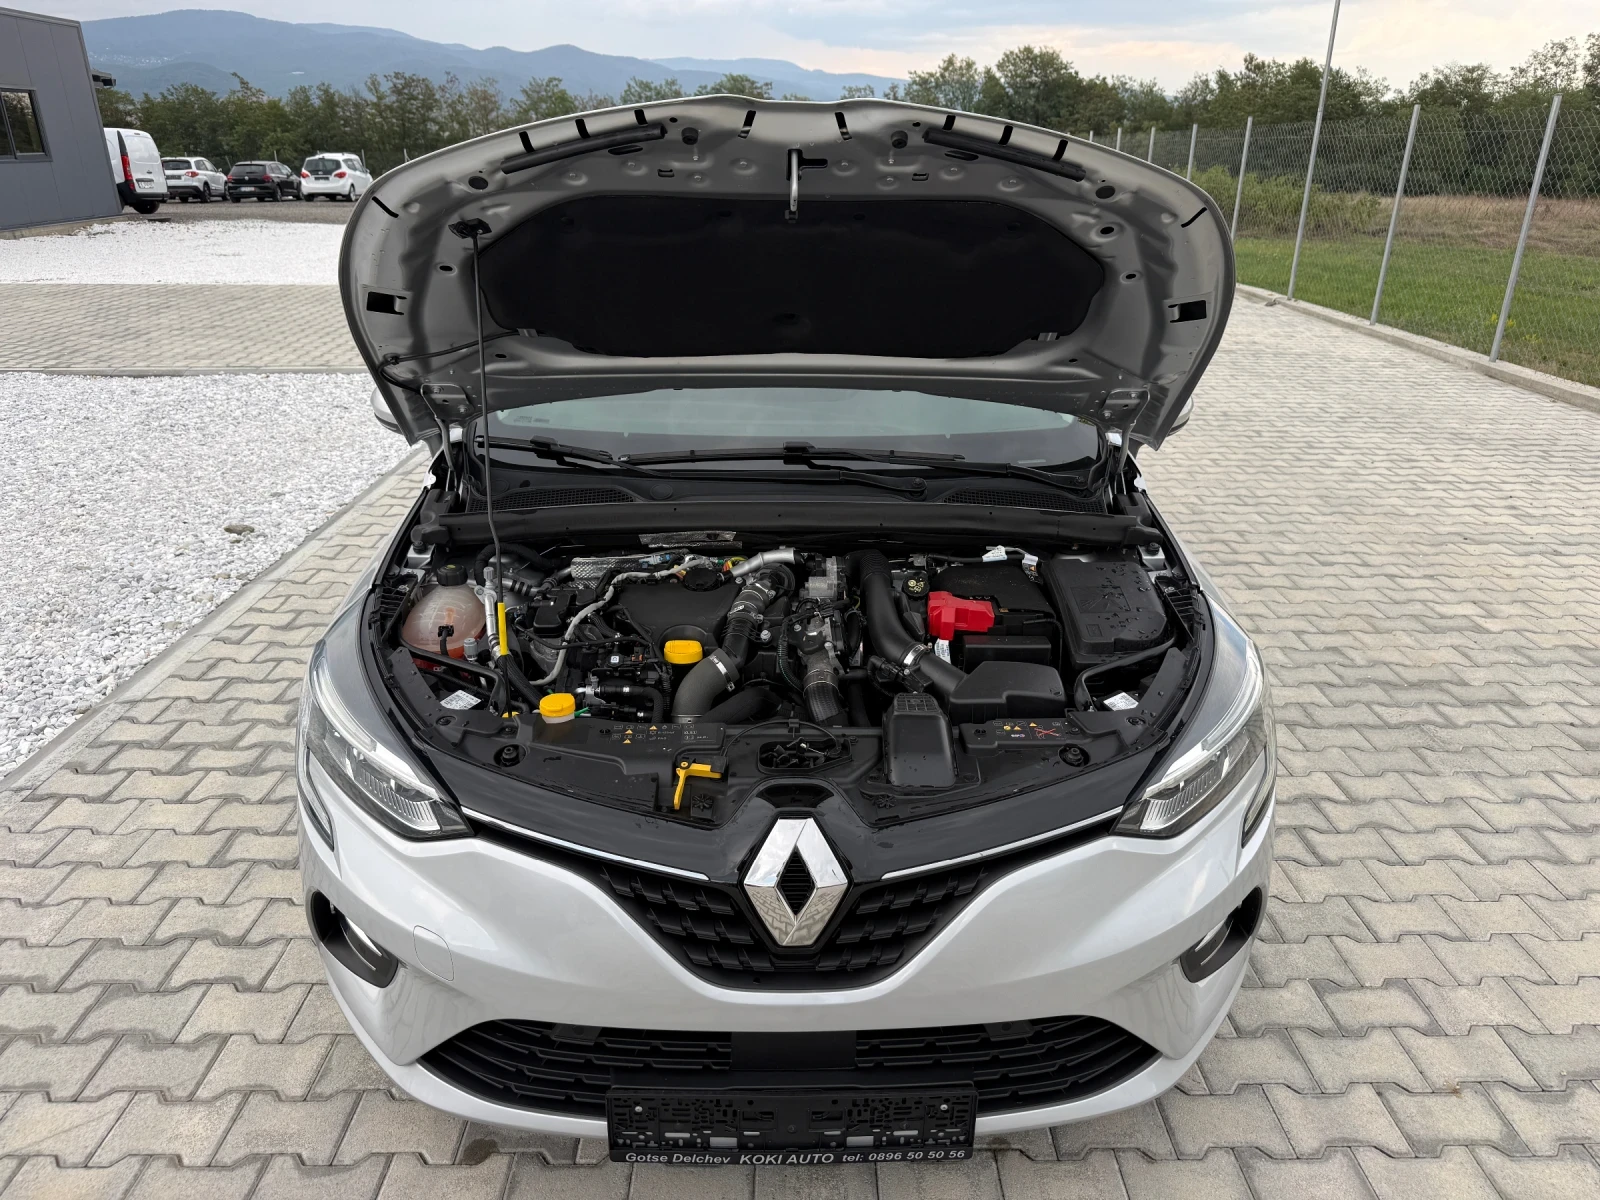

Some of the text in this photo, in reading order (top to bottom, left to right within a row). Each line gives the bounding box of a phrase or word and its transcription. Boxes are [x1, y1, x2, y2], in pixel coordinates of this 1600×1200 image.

[625, 1150, 966, 1165] Gotse Delchev KOKI AUTO tel: 0896 50 50 56
